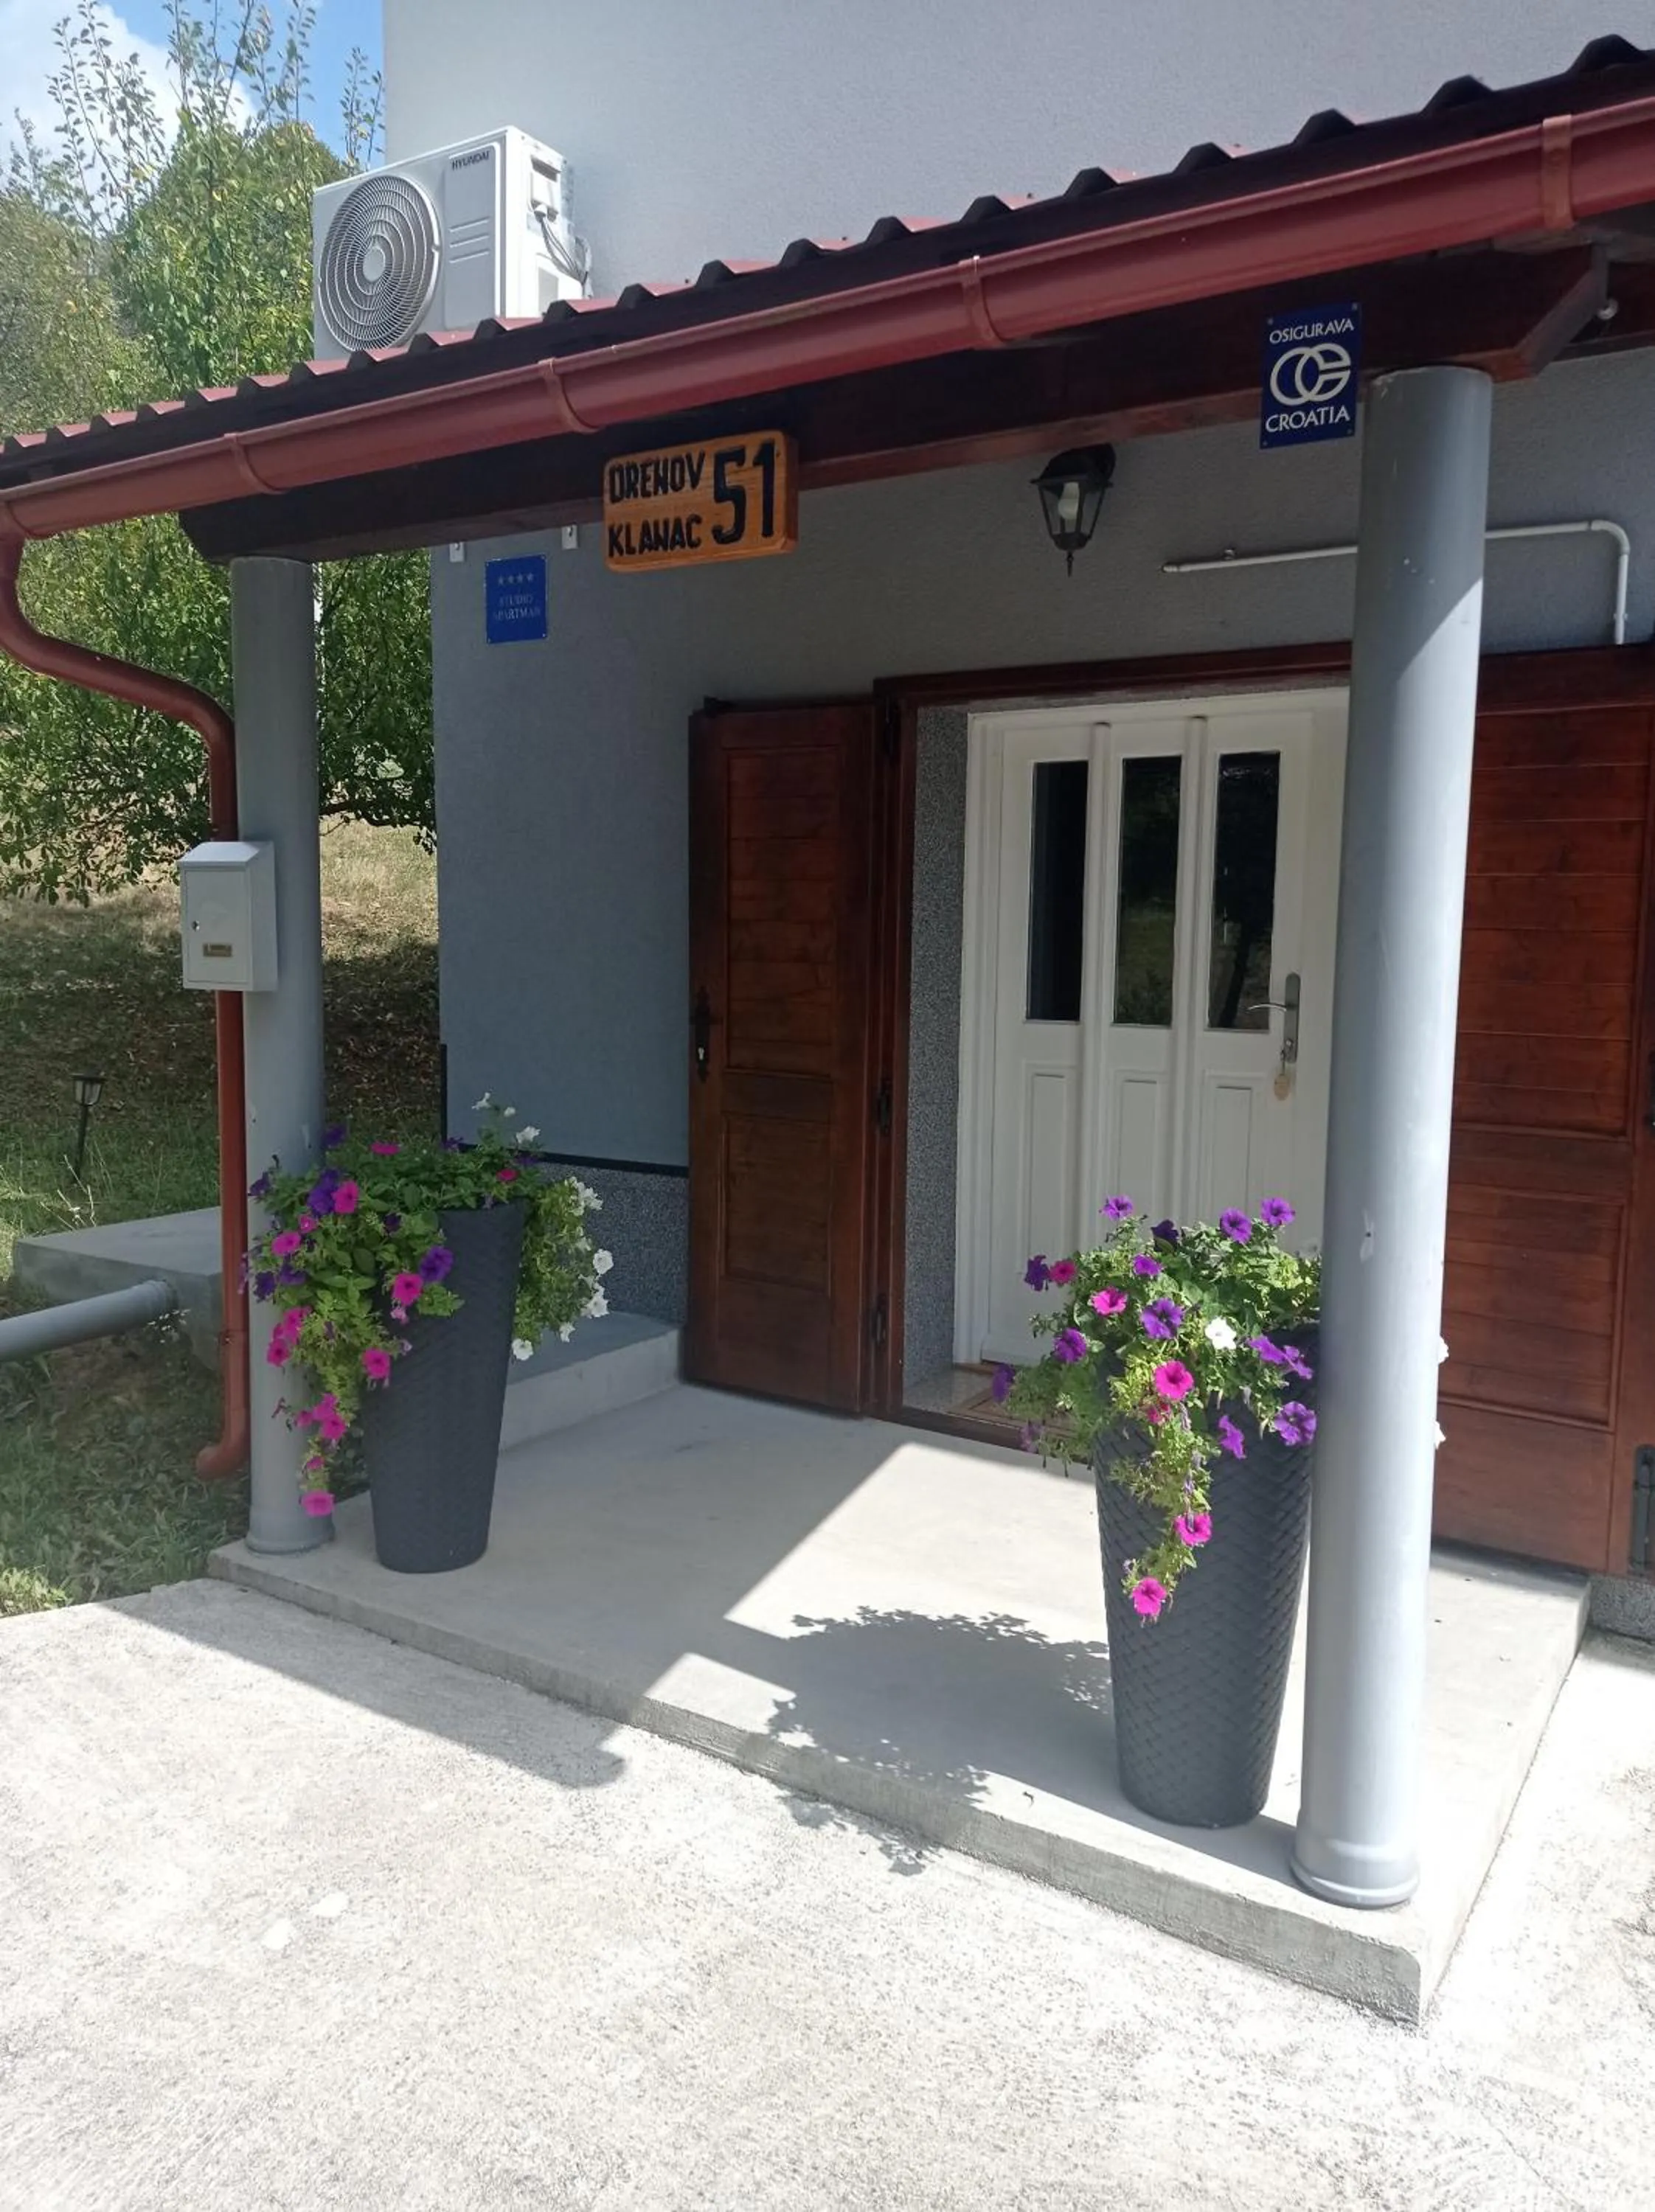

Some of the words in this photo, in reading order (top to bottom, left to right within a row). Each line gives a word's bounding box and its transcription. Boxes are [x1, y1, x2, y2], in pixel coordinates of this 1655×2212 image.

[451, 150, 489, 170] HYUNDAI
[1269, 318, 1354, 344] OSIGURAVA
[1265, 405, 1350, 432] CROATIA
[711, 438, 775, 544] 51
[608, 515, 702, 557] KLANAC
